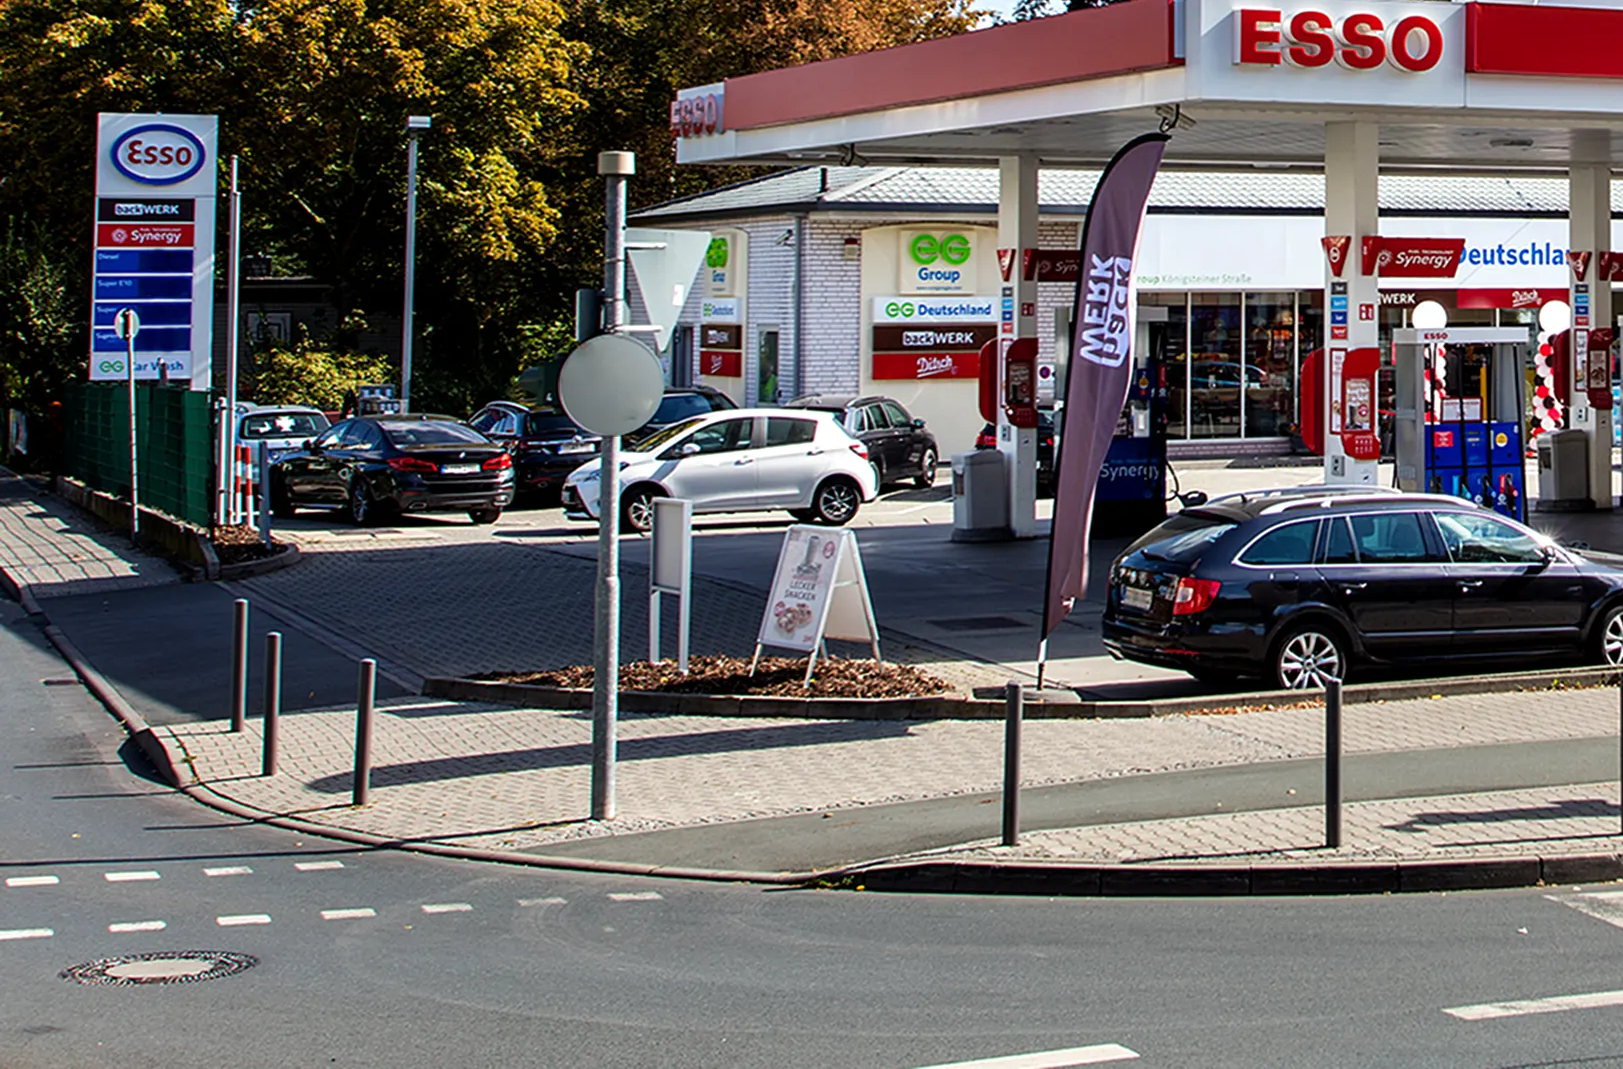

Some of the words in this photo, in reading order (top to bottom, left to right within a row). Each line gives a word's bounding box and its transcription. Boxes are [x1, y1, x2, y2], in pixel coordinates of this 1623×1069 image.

[1236, 7, 1443, 72] ESSO
[670, 93, 717, 137] ESSO
[127, 139, 192, 165] Esso
[131, 230, 181, 243] Synergy
[1395, 251, 1453, 269] Synergy
[1459, 242, 1569, 266] eutschla
[917, 267, 961, 283] Group
[1055, 261, 1079, 275] Syn
[1137, 275, 1159, 285] roup
[1376, 292, 1416, 306] WERK
[917, 304, 992, 316] Deutschland
